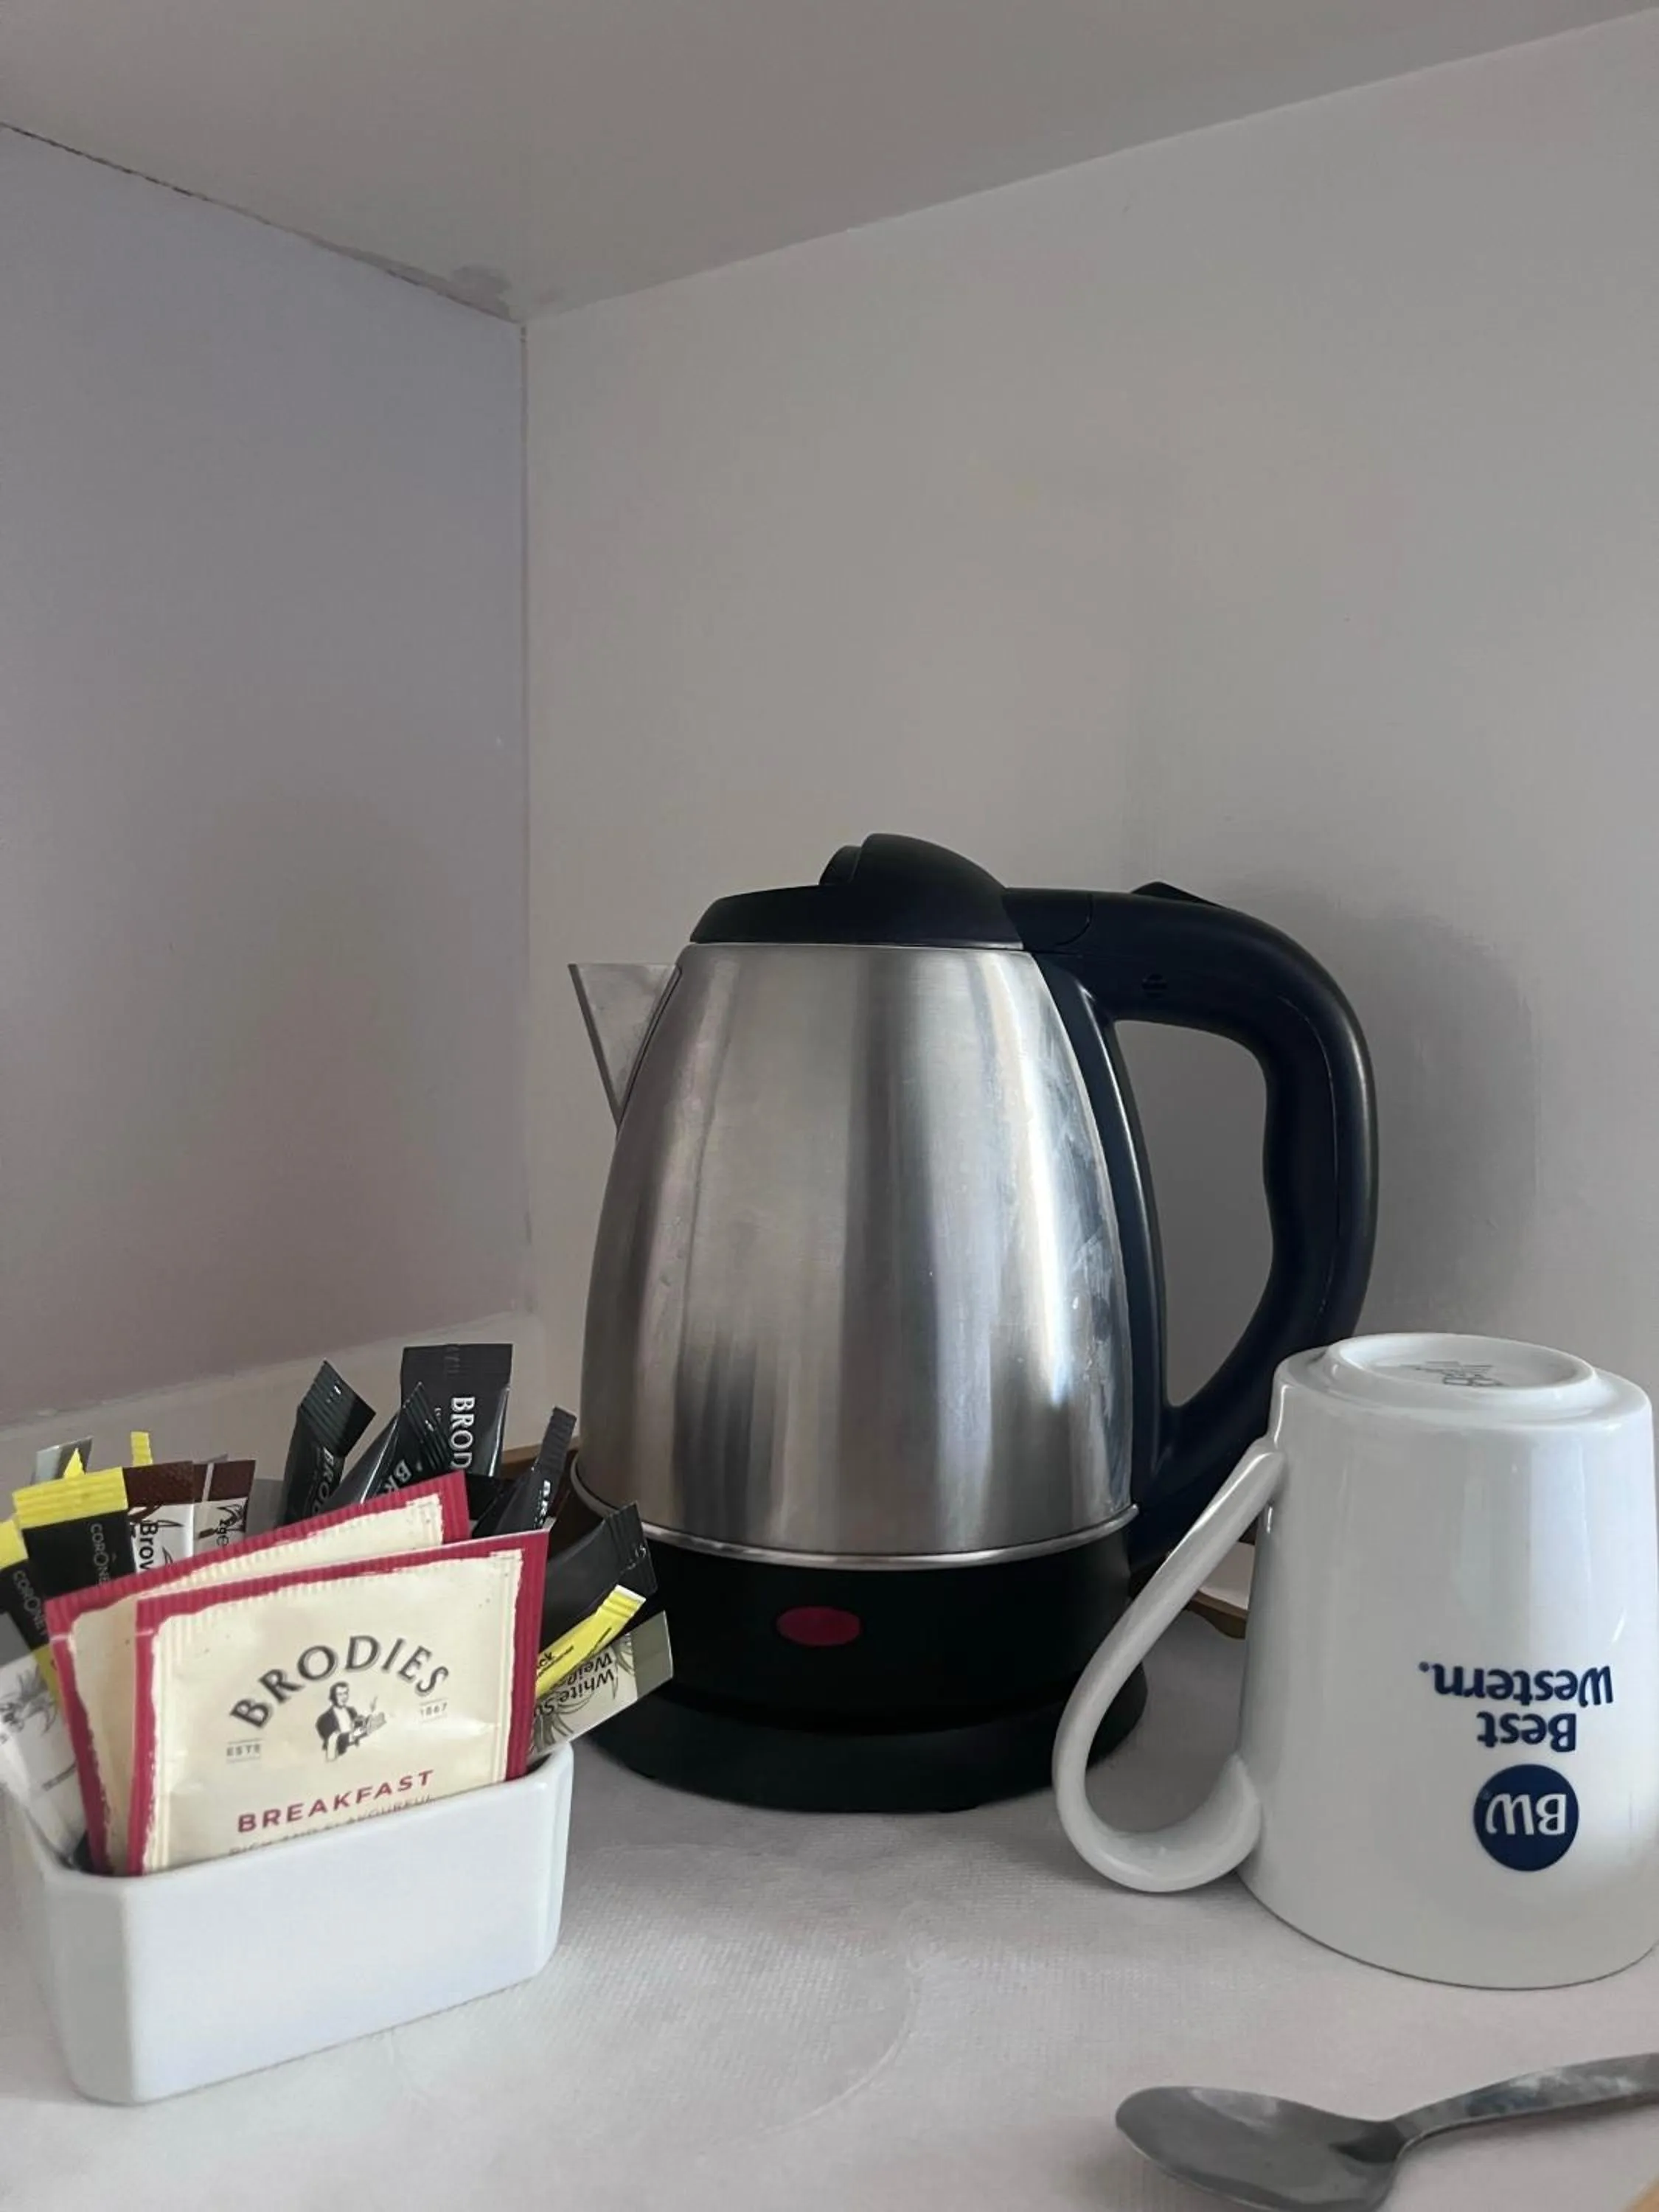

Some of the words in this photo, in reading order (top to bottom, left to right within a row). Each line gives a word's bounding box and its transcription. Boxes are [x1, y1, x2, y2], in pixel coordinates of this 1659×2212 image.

[229, 1635, 449, 1729] BRODIES
[560, 1669, 614, 1703] White
[1476, 1711, 1576, 1753] Best
[237, 1770, 434, 1833] BREAKFAST
[1485, 1793, 1567, 1835] BW
